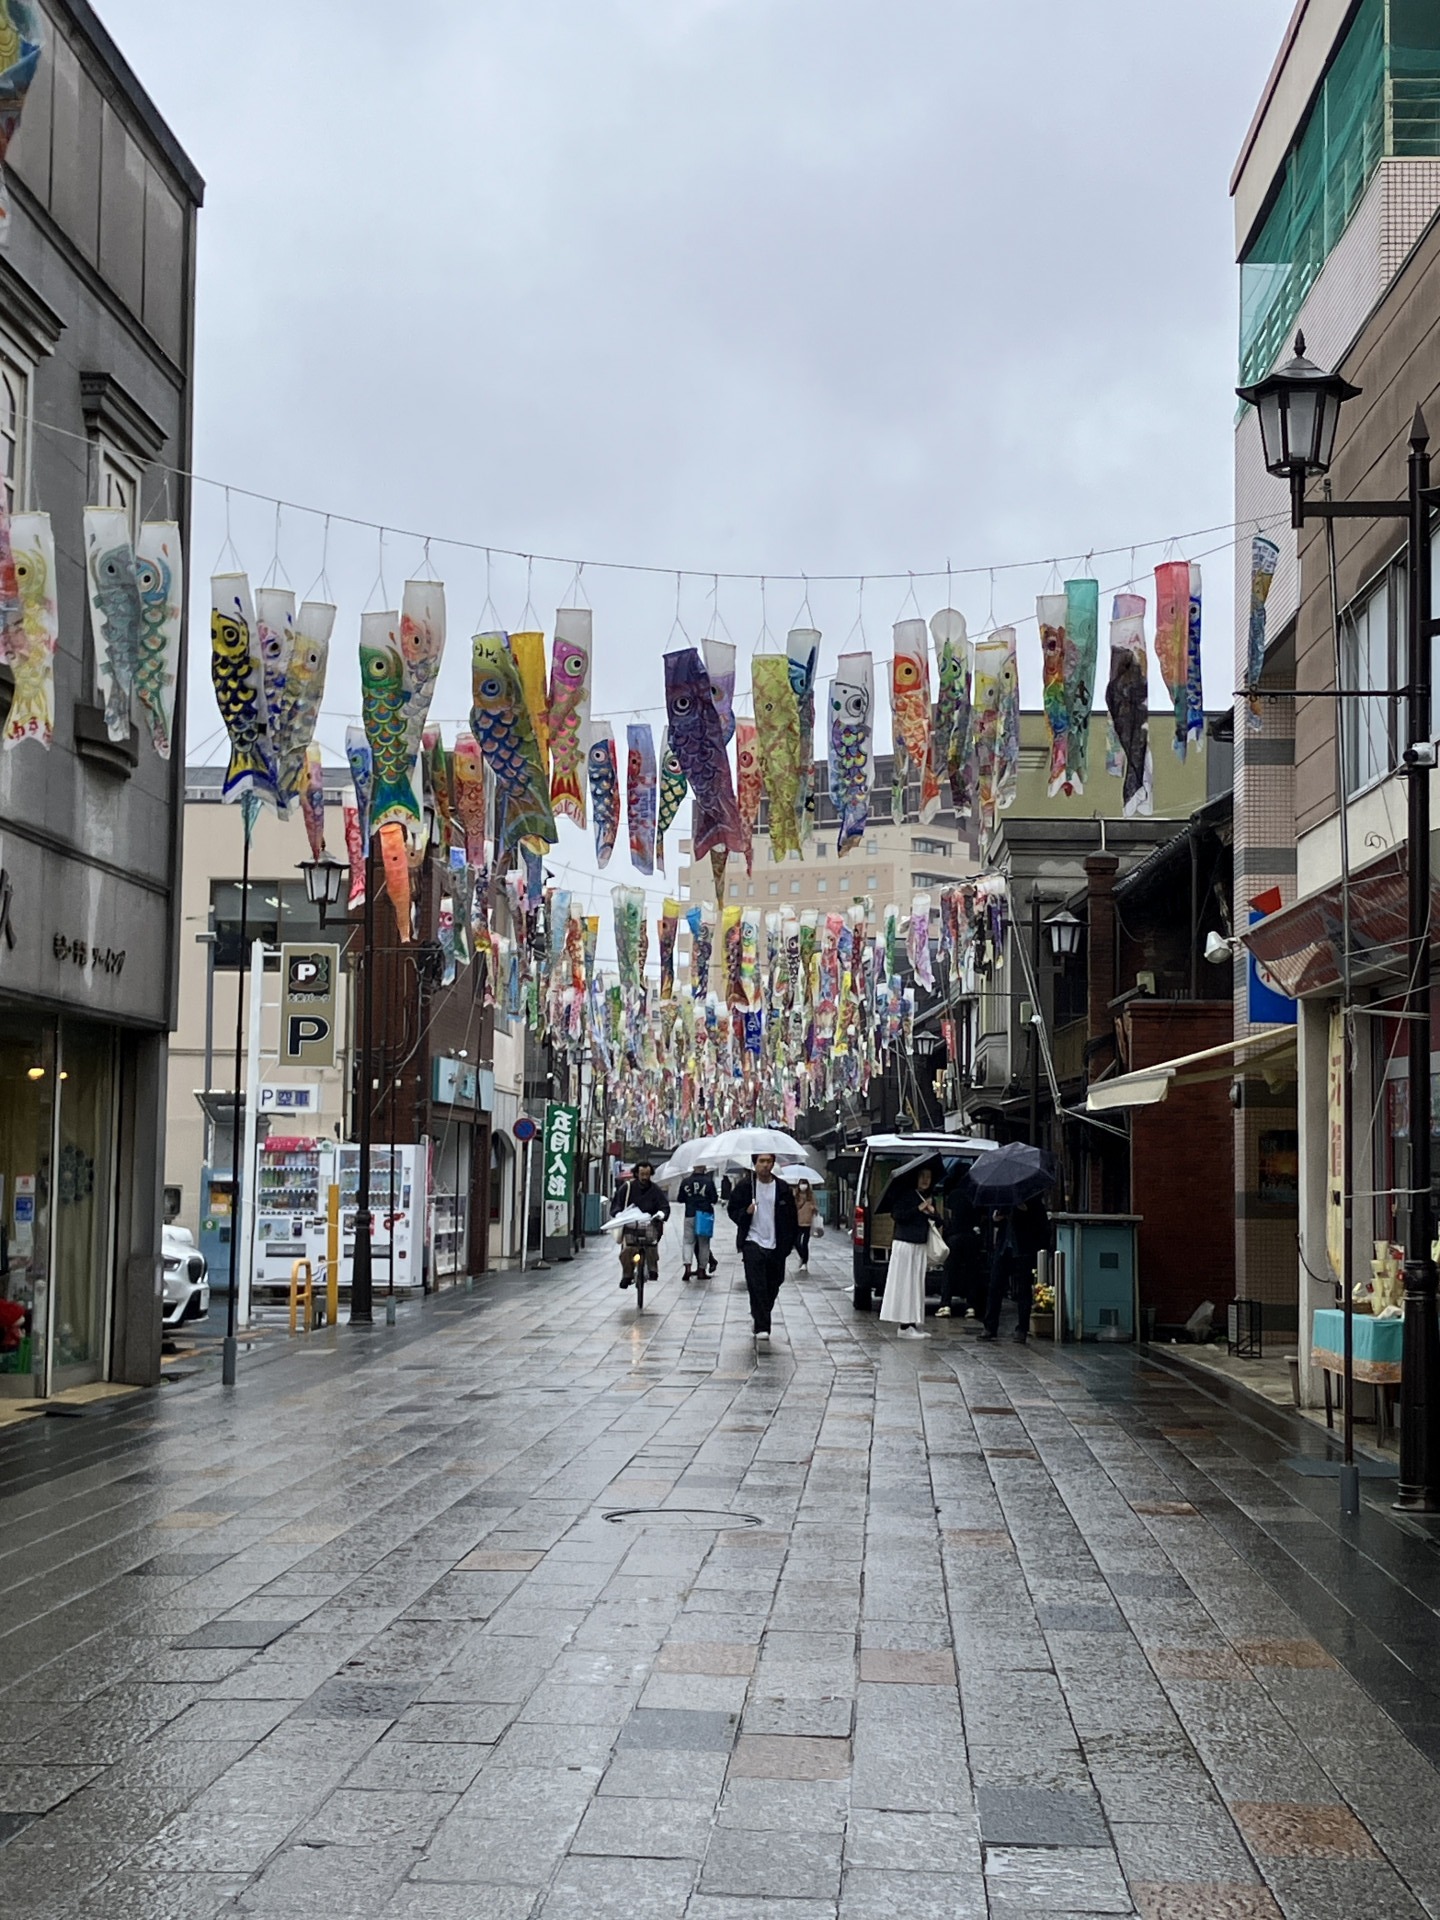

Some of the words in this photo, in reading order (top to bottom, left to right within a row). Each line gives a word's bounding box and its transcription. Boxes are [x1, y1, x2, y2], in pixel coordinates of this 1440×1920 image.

[297, 963, 317, 981] P
[287, 1014, 331, 1058] P
[261, 1088, 274, 1107] P
[277, 1089, 310, 1106] 空車
[547, 1109, 574, 1197] 五月人形
